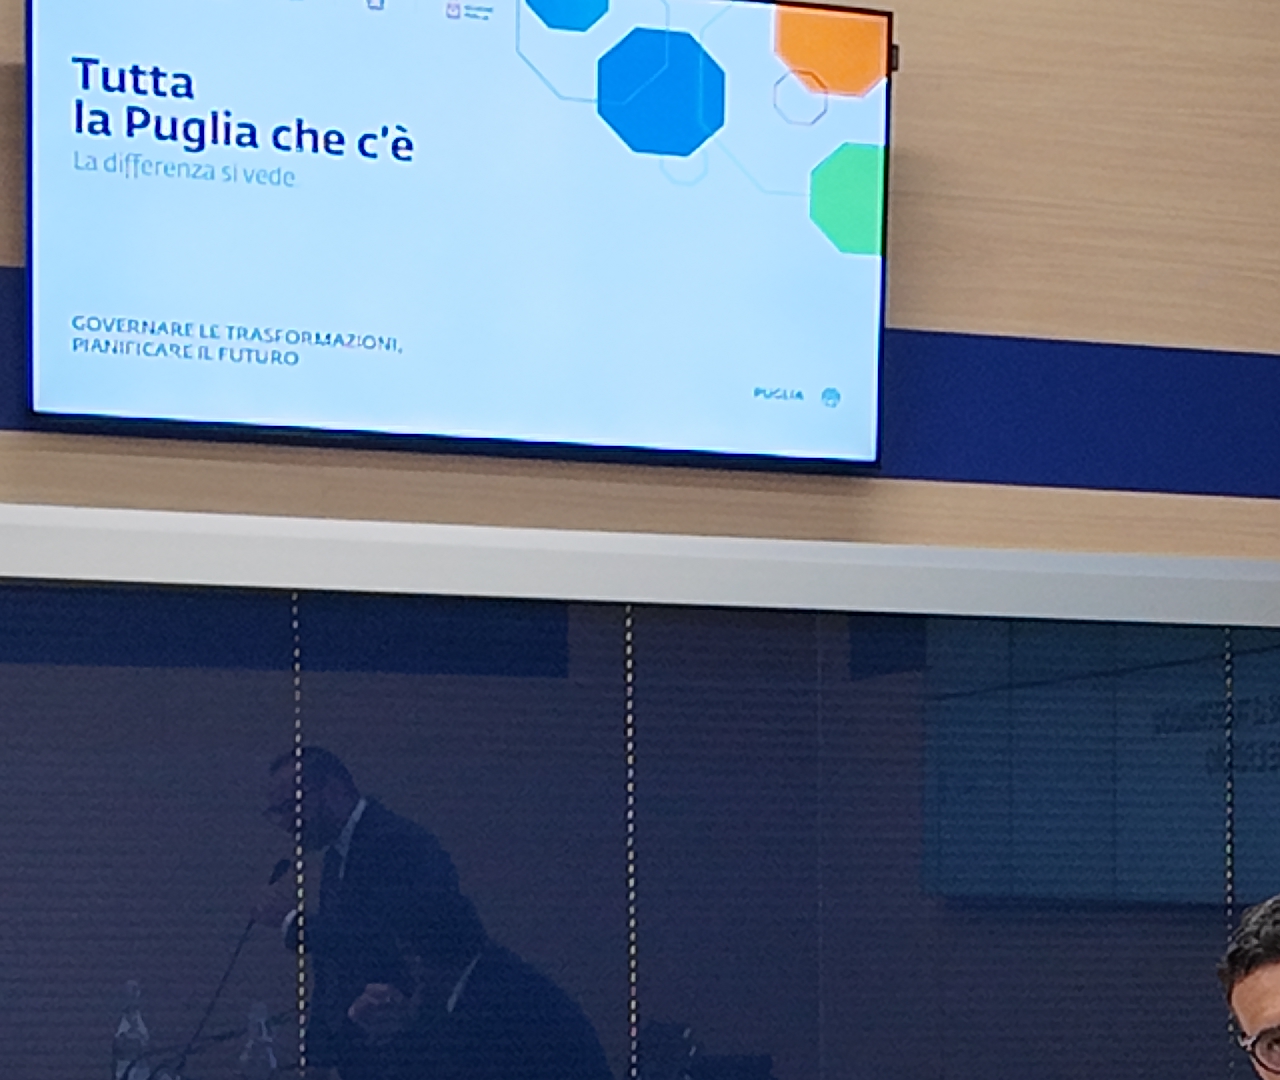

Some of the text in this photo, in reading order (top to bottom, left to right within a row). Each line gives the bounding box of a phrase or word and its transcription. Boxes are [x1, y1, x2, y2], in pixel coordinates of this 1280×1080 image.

[72, 56, 195, 100] Tutta
[75, 99, 112, 136] la
[126, 105, 259, 153] Puglia
[272, 117, 345, 156] che
[74, 151, 296, 187] La differenza si vede
[72, 316, 194, 338] GOVERNARE
[199, 323, 221, 340] LE
[72, 338, 193, 360] PIANIFICARE
[219, 347, 300, 367] FUTURO
